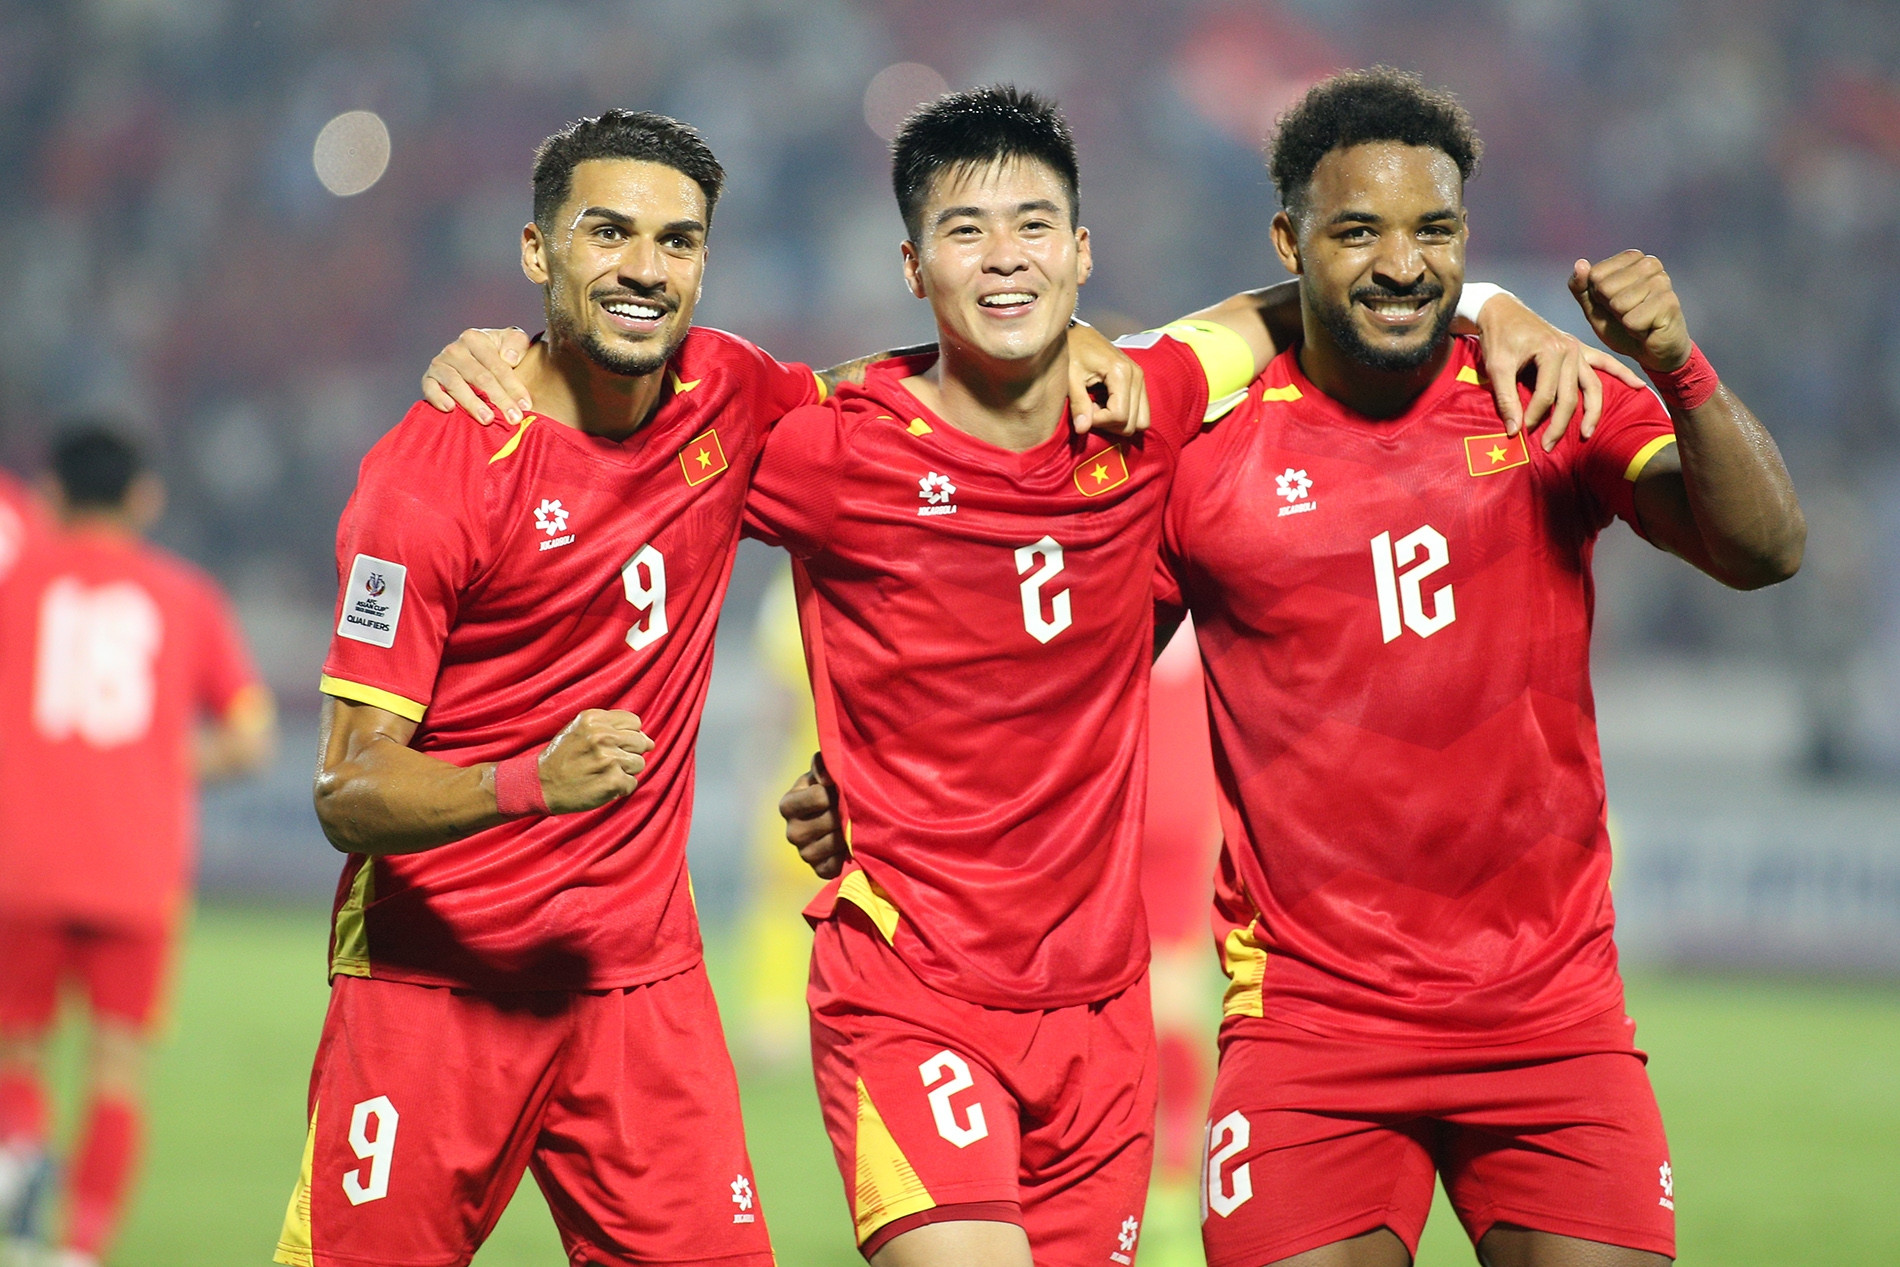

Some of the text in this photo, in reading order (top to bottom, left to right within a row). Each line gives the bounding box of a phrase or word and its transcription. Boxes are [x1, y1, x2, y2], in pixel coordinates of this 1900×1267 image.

[347, 615, 390, 631] QUALIFIERS
[621, 542, 669, 651] 9
[1014, 534, 1072, 644] 2
[1370, 524, 1456, 644] 12
[342, 1095, 399, 1206] 9
[918, 1050, 988, 1149] 2
